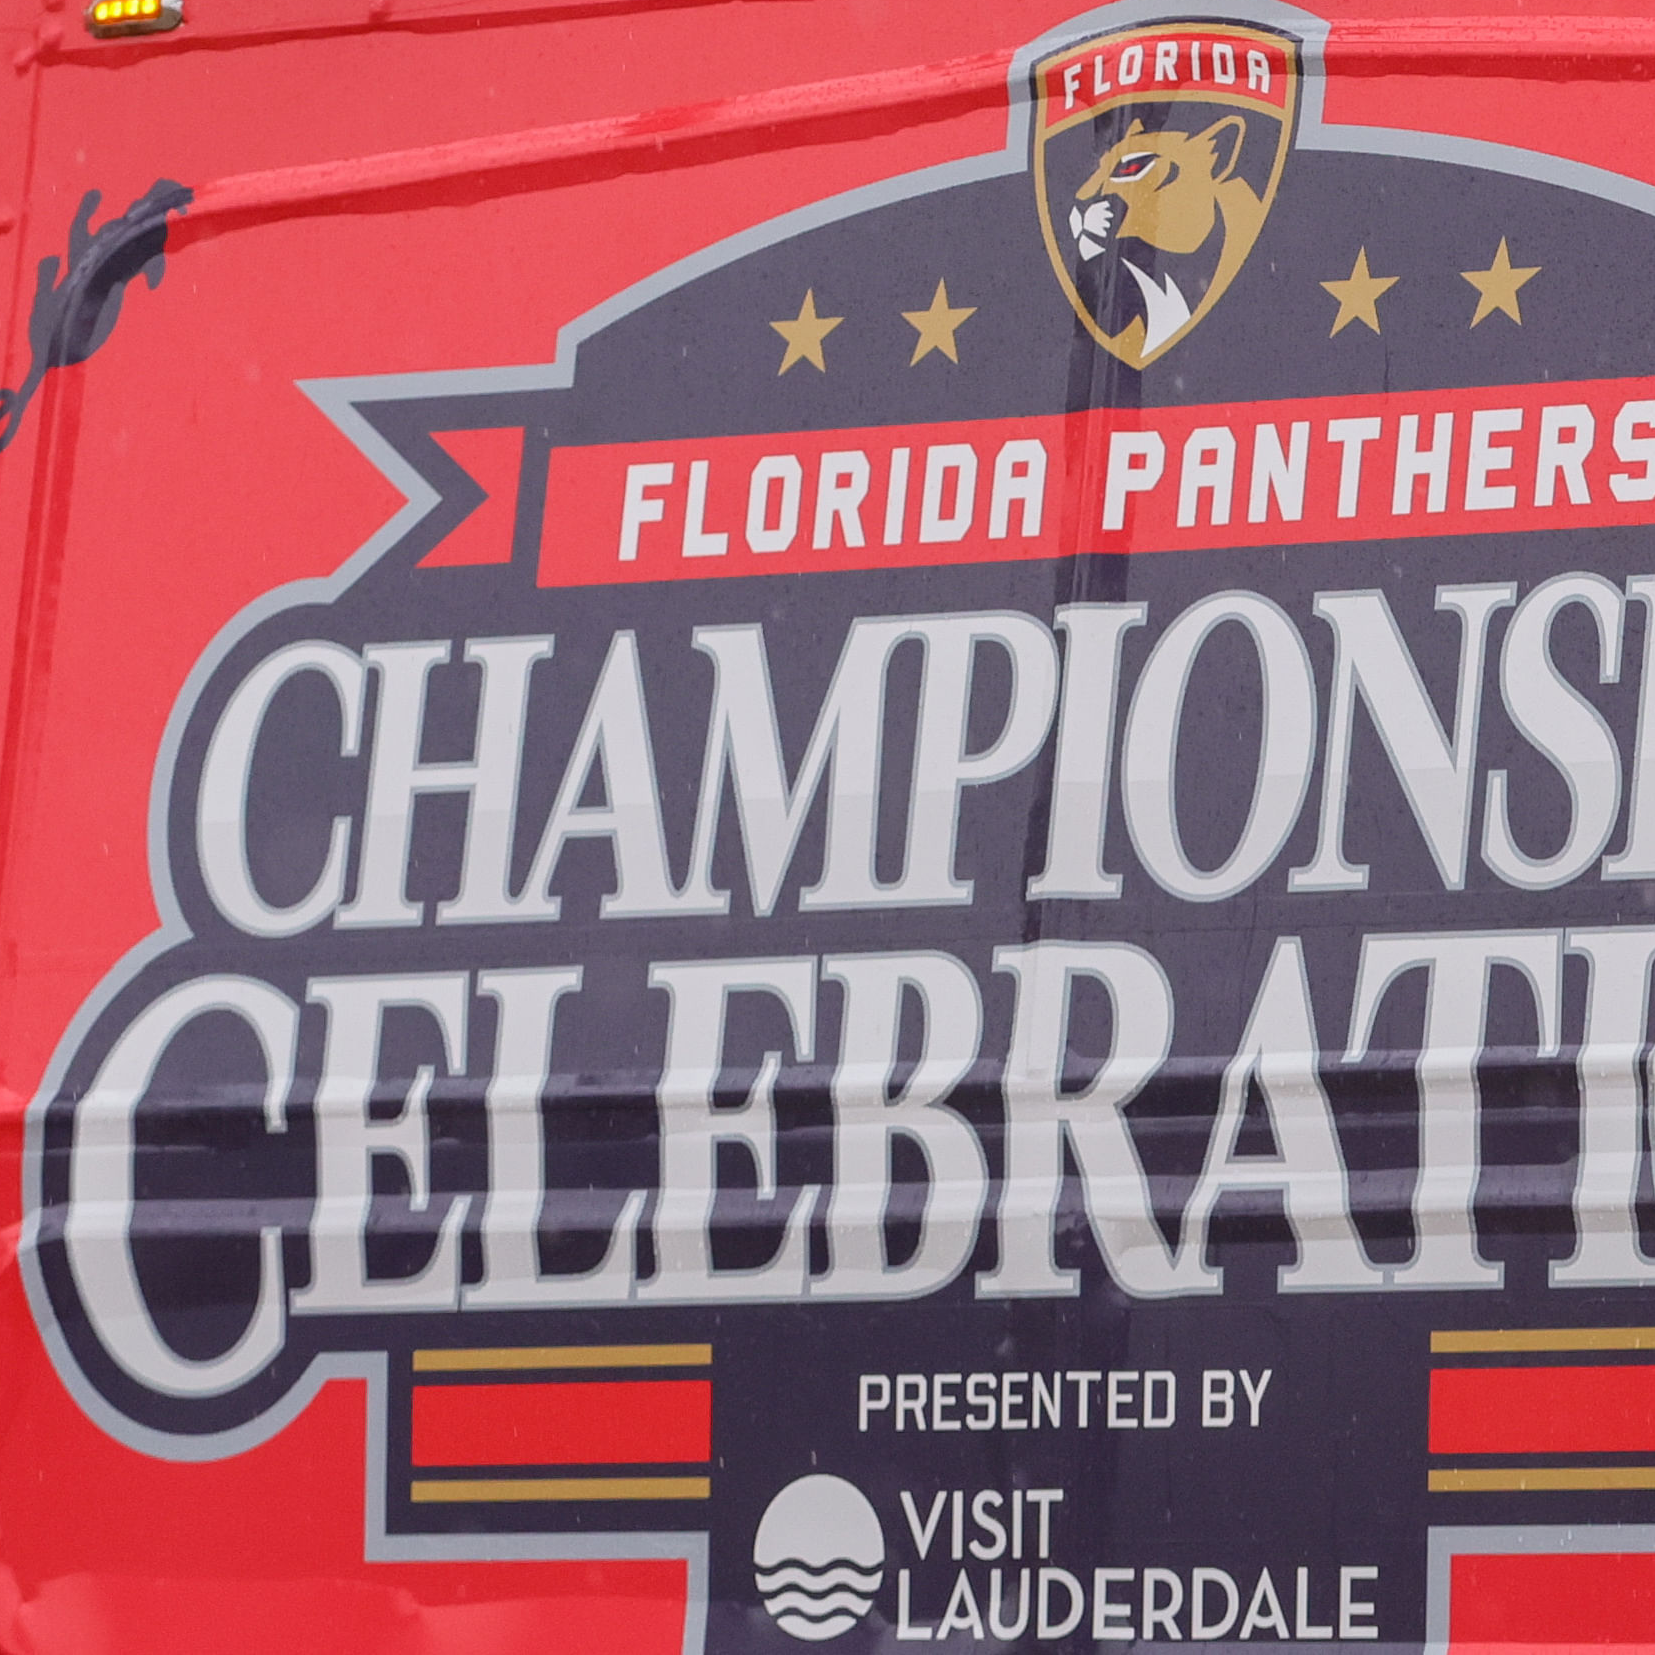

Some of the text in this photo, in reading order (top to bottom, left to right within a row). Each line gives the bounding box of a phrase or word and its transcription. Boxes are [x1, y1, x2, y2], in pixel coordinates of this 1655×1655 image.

[1062, 40, 1272, 111] FLORIDA
[617, 438, 1050, 561] FLORIDA
[858, 1368, 1273, 1432] PRESENTED BY
[899, 1487, 1064, 1561] VISIT
[896, 1564, 1381, 1642] LAUDERDALE
